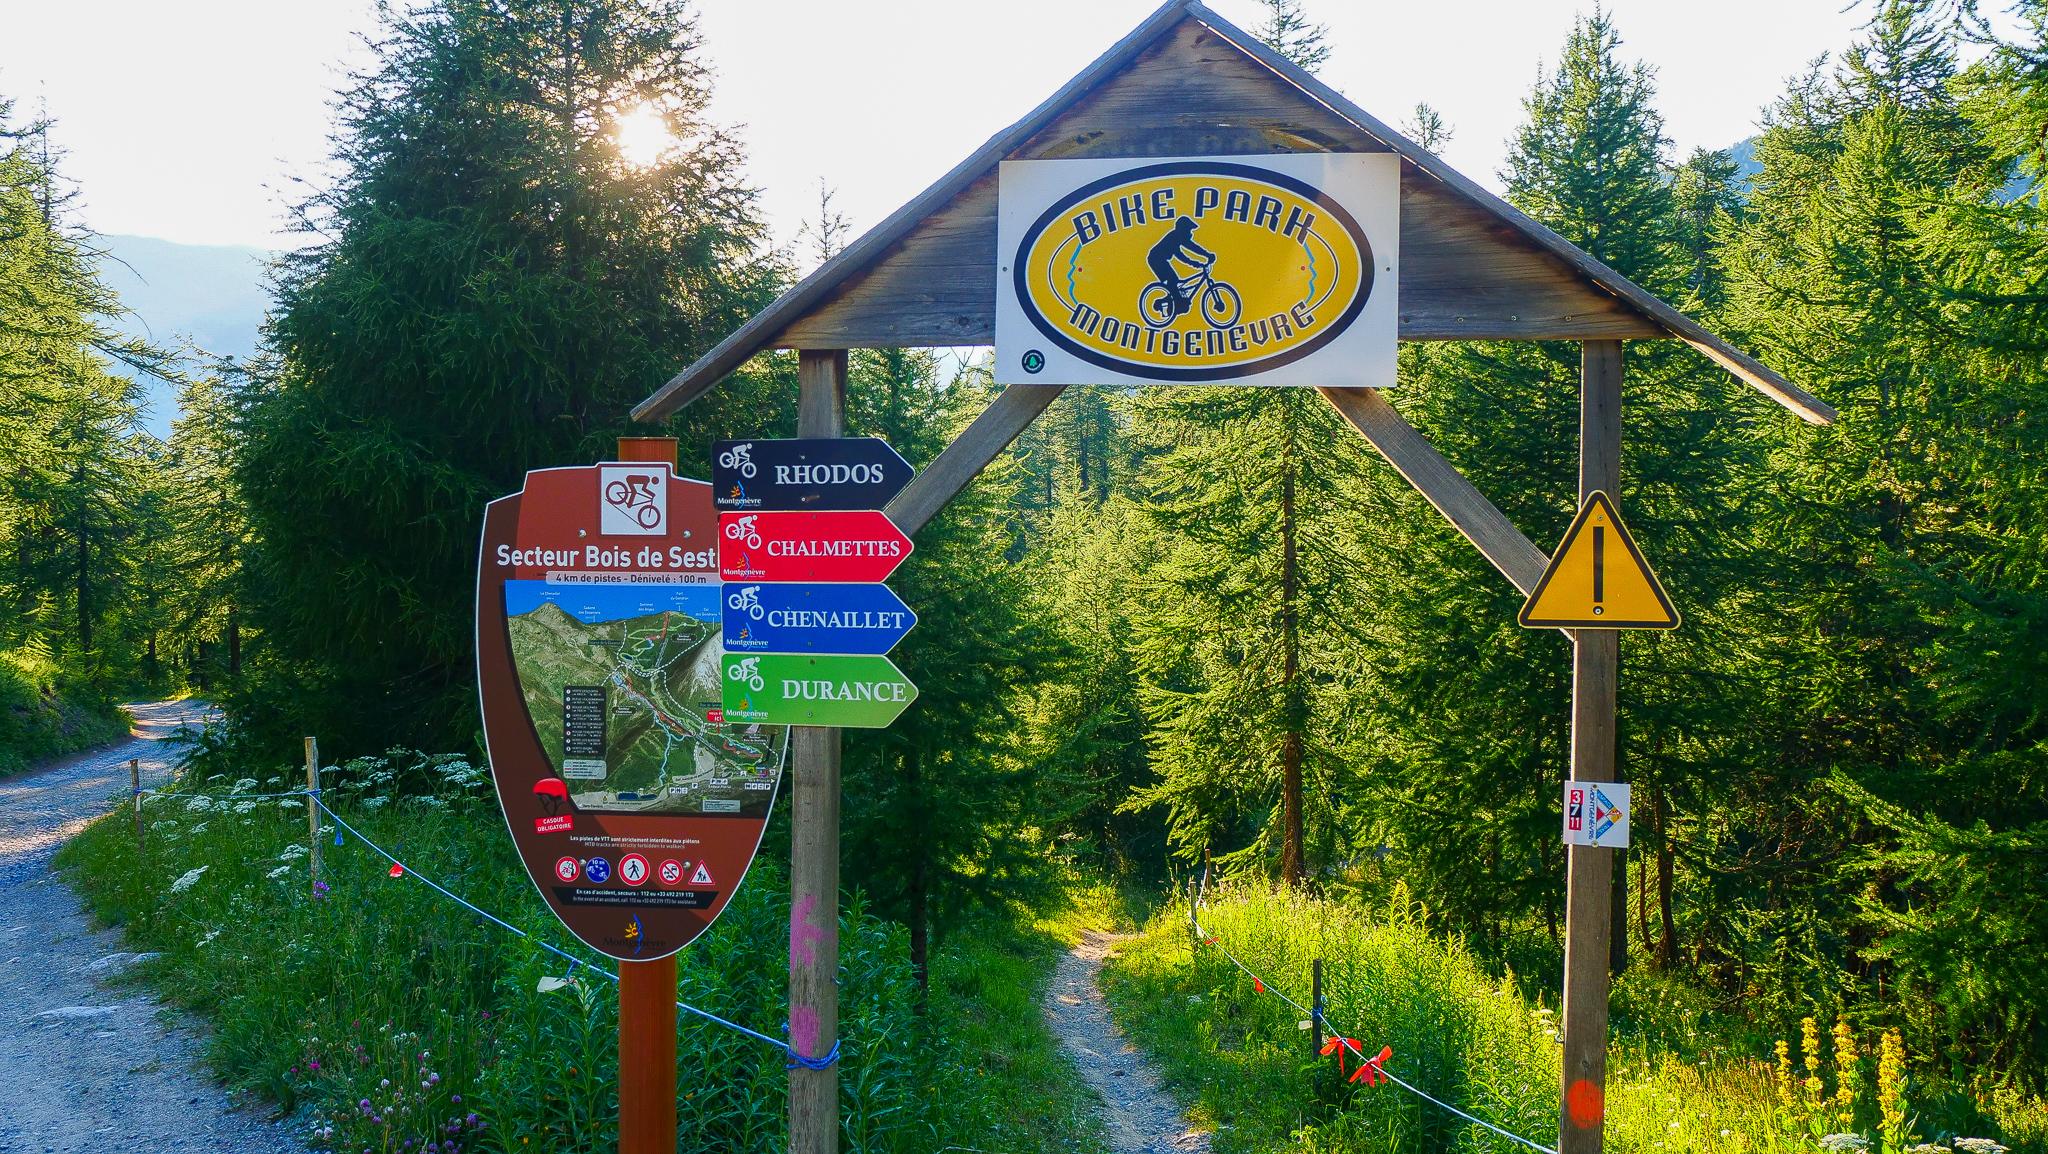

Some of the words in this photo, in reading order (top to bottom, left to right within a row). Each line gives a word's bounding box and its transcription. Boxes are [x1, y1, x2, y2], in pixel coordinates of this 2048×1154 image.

[1071, 187, 1176, 246] BIKE
[1194, 186, 1316, 247] PARK
[1069, 301, 1315, 356] MONTGENEVRE
[775, 463, 884, 485] RHODOS
[497, 544, 580, 566] Secteur
[585, 546, 632, 568] Bois
[637, 546, 664, 568] de
[669, 547, 720, 568] Sest
[767, 540, 900, 557] CHALMETTES
[564, 575, 577, 583] km
[580, 575, 591, 583] de
[593, 575, 622, 585] pistes
[630, 574, 671, 584] Dénivelé
[679, 575, 695, 584] 100
[767, 610, 905, 630] CHENAILLET
[782, 680, 907, 702] DURANCE
[1572, 791, 1581, 804] 3
[1571, 804, 1580, 816] 7
[537, 822, 571, 832] OBLIGATOIRE
[543, 816, 564, 824] CASQUE
[1570, 817, 1580, 828] 11
